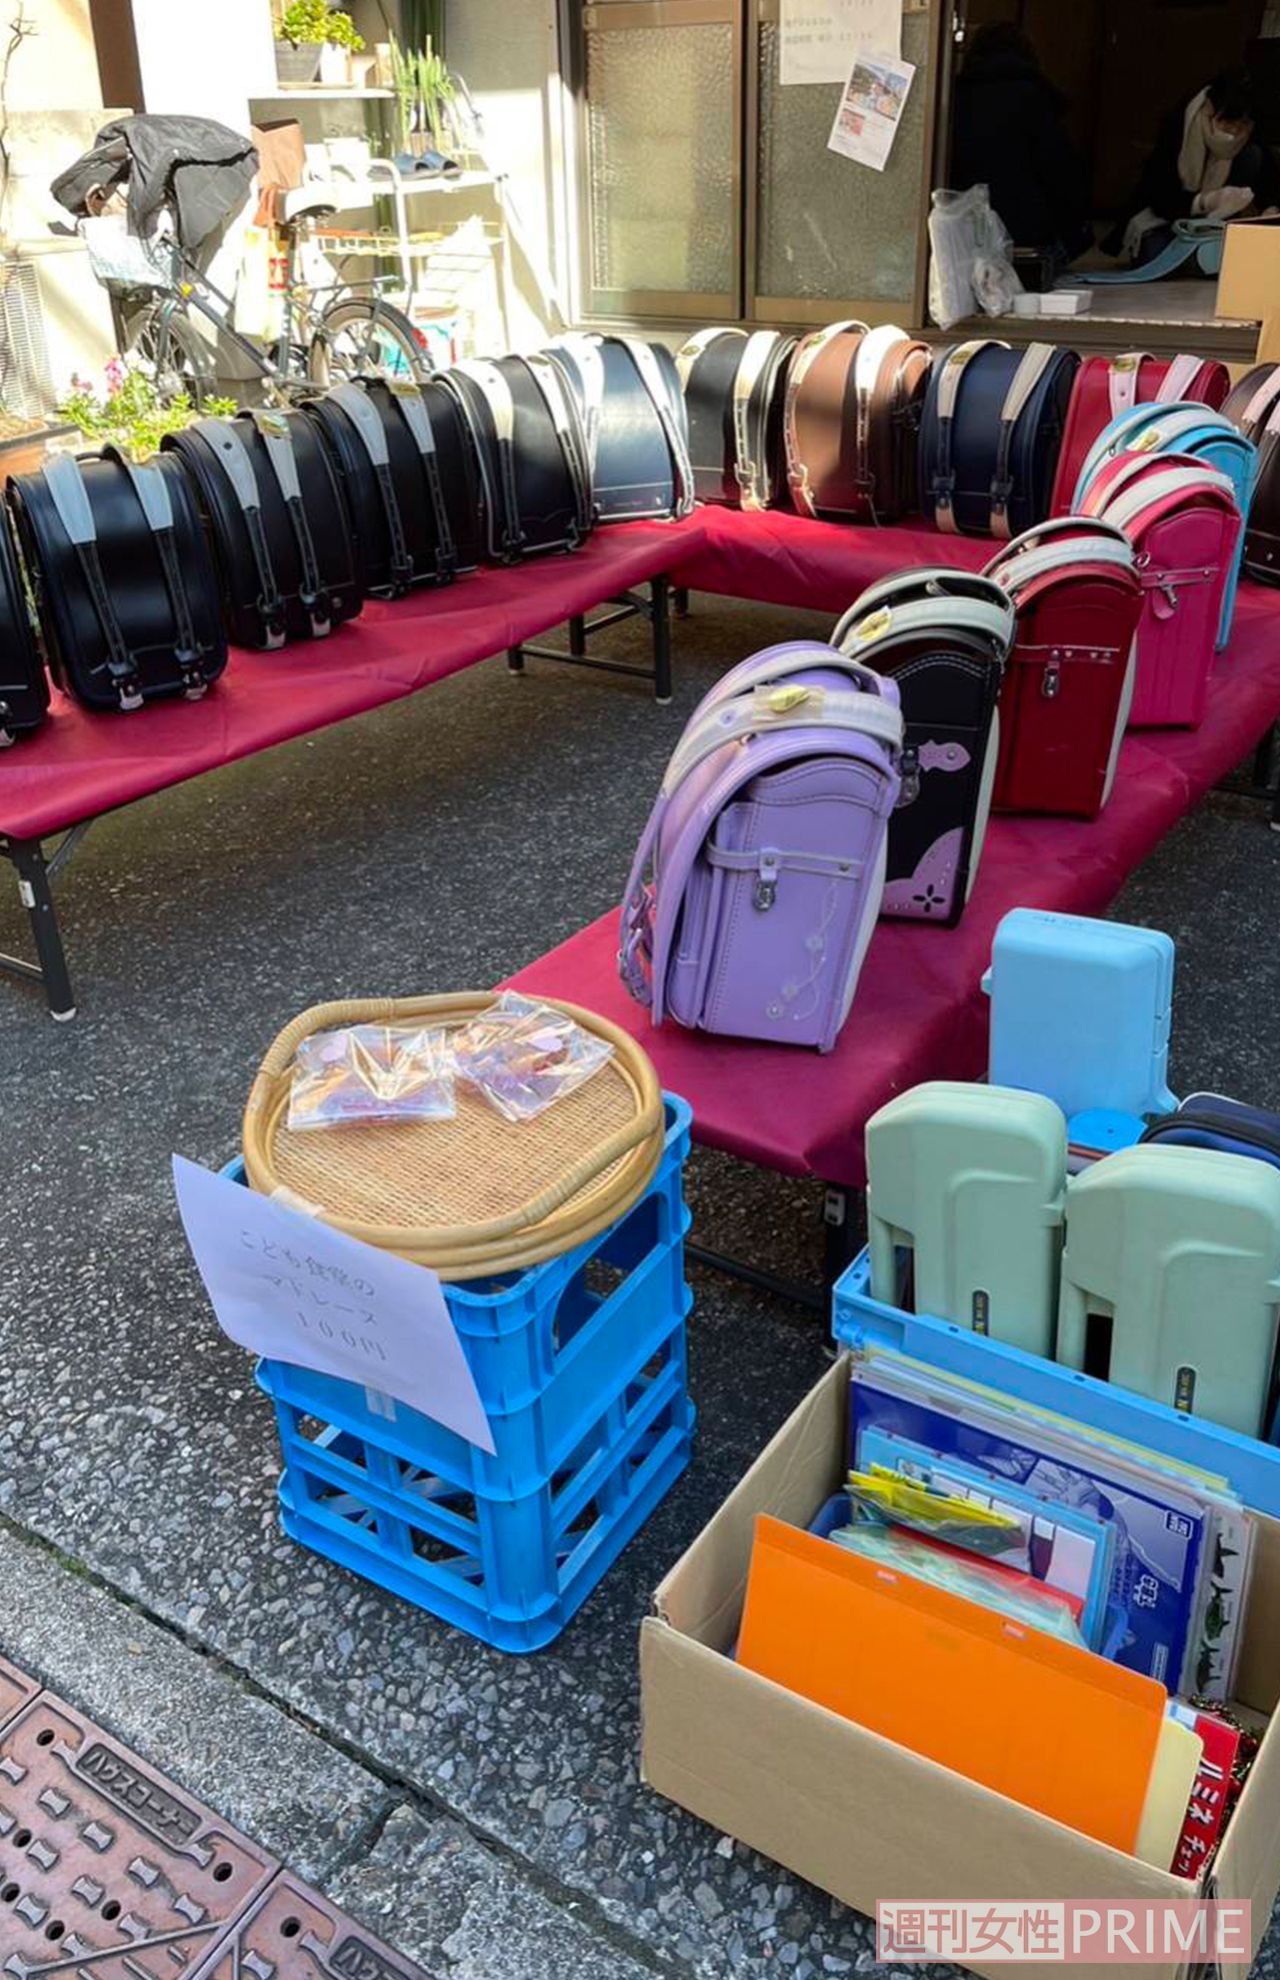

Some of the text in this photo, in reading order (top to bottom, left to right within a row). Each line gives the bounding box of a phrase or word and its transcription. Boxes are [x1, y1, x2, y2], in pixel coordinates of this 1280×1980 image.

[82, 1746, 198, 1838] ハウスコーナー
